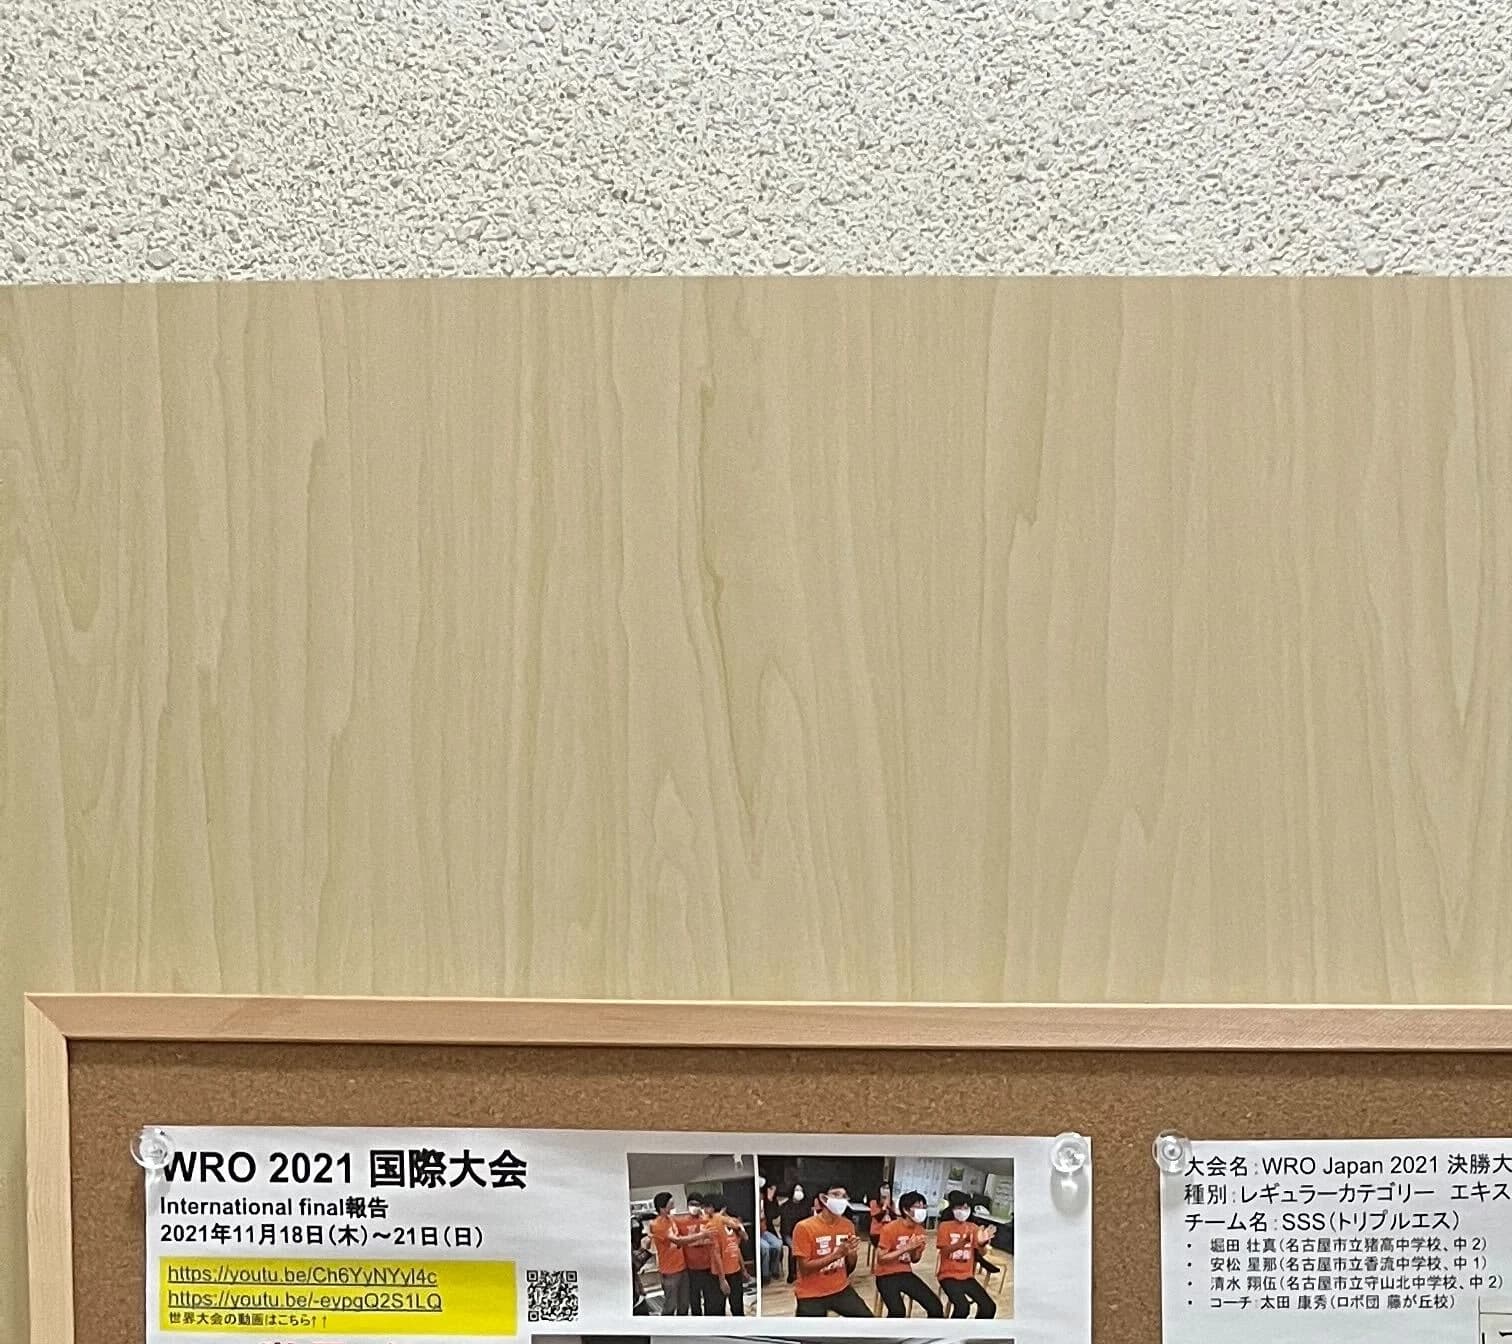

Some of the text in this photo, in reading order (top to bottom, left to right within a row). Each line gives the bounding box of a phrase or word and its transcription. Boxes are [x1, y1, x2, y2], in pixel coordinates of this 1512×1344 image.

[161, 1149, 528, 1189] WRO 2021 国際大会
[1323, 1156, 1383, 1179] Japan
[1391, 1156, 1437, 1174] 2021
[160, 1197, 292, 1218] International
[1210, 1257, 1240, 1272] 安松
[1210, 1276, 1240, 1291] 清水
